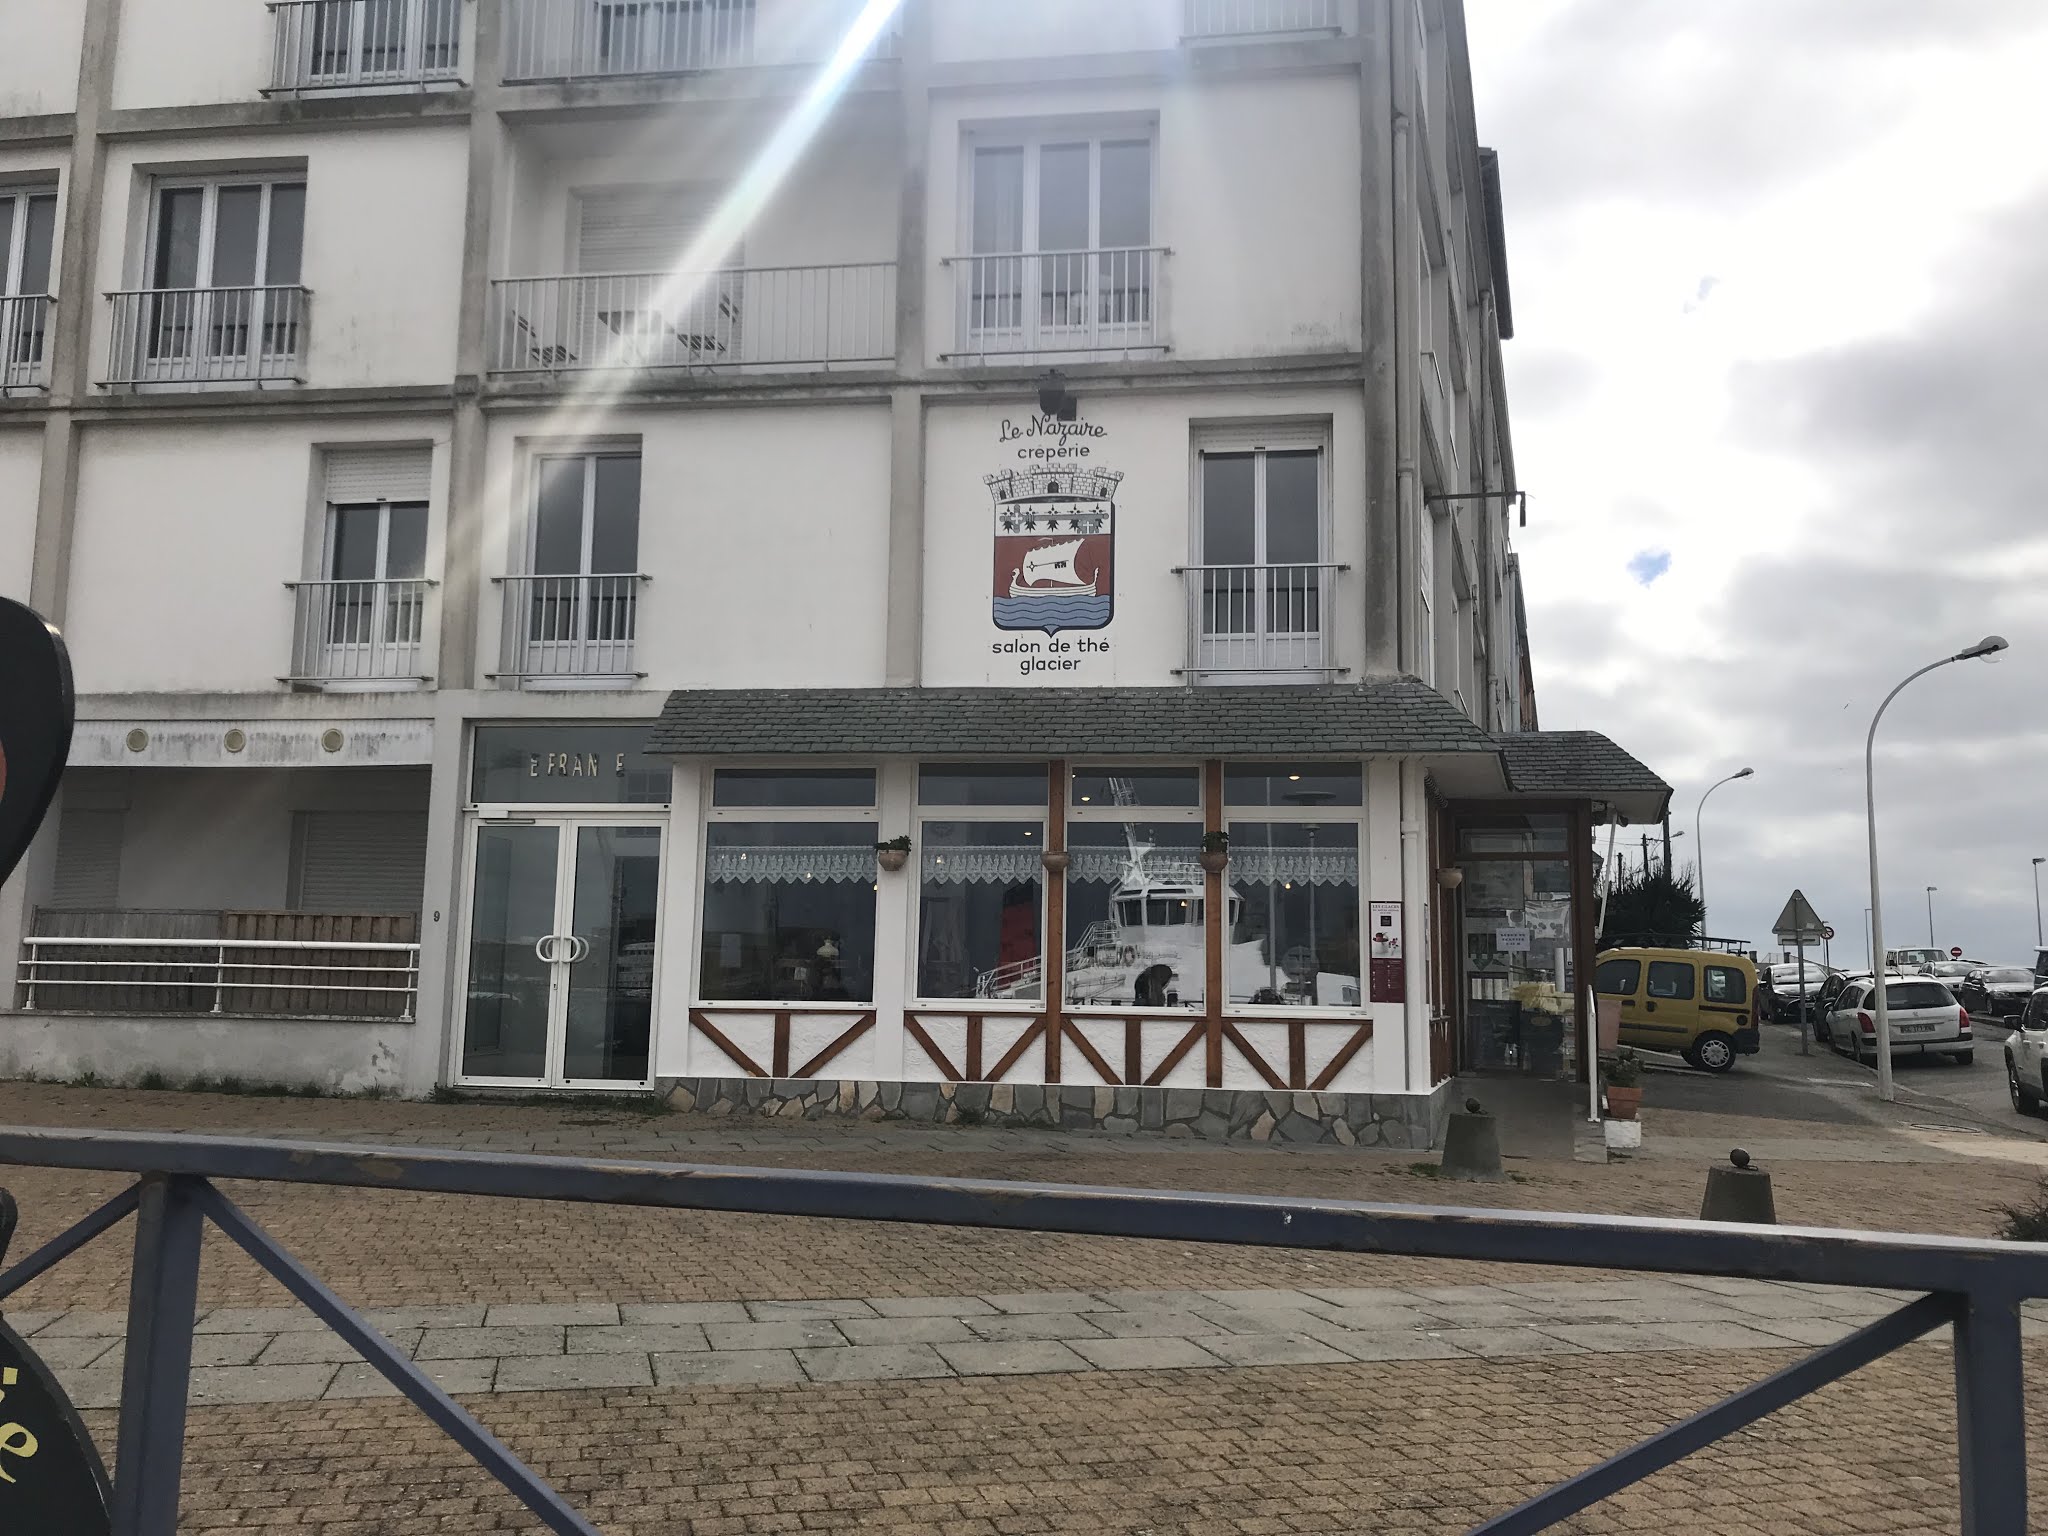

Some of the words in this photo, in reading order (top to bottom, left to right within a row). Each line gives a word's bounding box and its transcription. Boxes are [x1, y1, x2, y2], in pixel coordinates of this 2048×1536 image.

[999, 419, 1023, 442] Le
[1026, 414, 1107, 446] Nazaire
[992, 638, 1041, 653] salon
[1048, 638, 1071, 652] de
[1077, 637, 1110, 653] thé
[1020, 655, 1081, 675] glacier
[433, 910, 441, 923] 9
